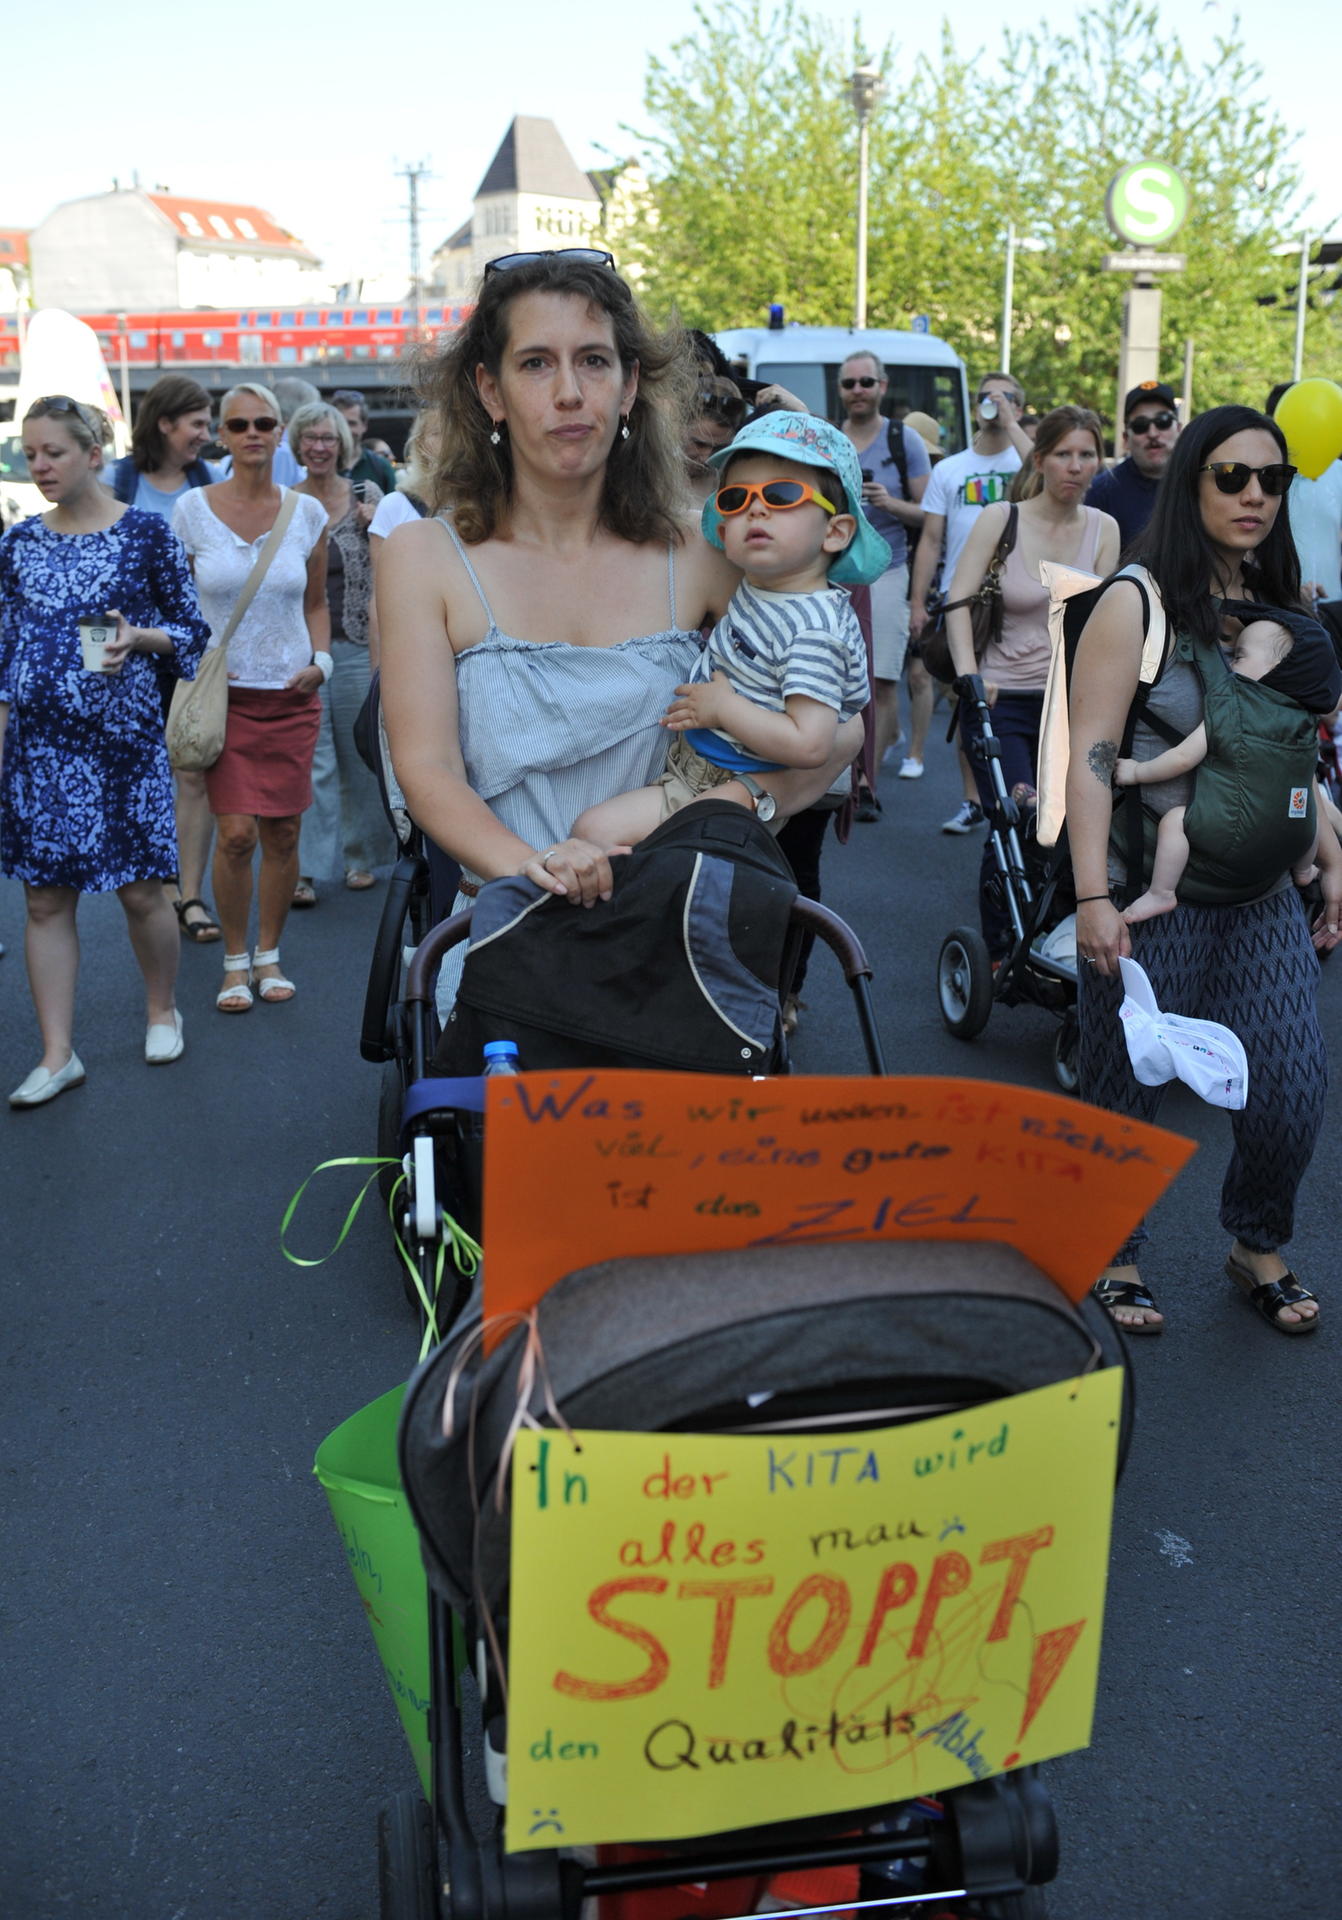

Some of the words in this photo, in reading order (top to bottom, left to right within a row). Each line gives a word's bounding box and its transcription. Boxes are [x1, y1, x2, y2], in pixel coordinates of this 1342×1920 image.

[1124, 168, 1175, 237] S
[515, 1075, 644, 1123] Was
[687, 1098, 780, 1121] wir
[1019, 1116, 1156, 1164] nicht
[842, 1140, 950, 1174] gute
[975, 1143, 1083, 1183] KITA
[606, 1180, 657, 1210] ist
[694, 1193, 762, 1218] das
[748, 1193, 1017, 1247] ZIEL
[536, 1440, 588, 1509] In
[643, 1454, 730, 1499] der
[768, 1448, 880, 1494] KITA
[914, 1423, 1009, 1480] wird
[619, 1521, 766, 1567] alles
[810, 1517, 928, 1557] mau
[530, 1736, 599, 1763] den
[644, 1704, 917, 1772] Qualitäts
